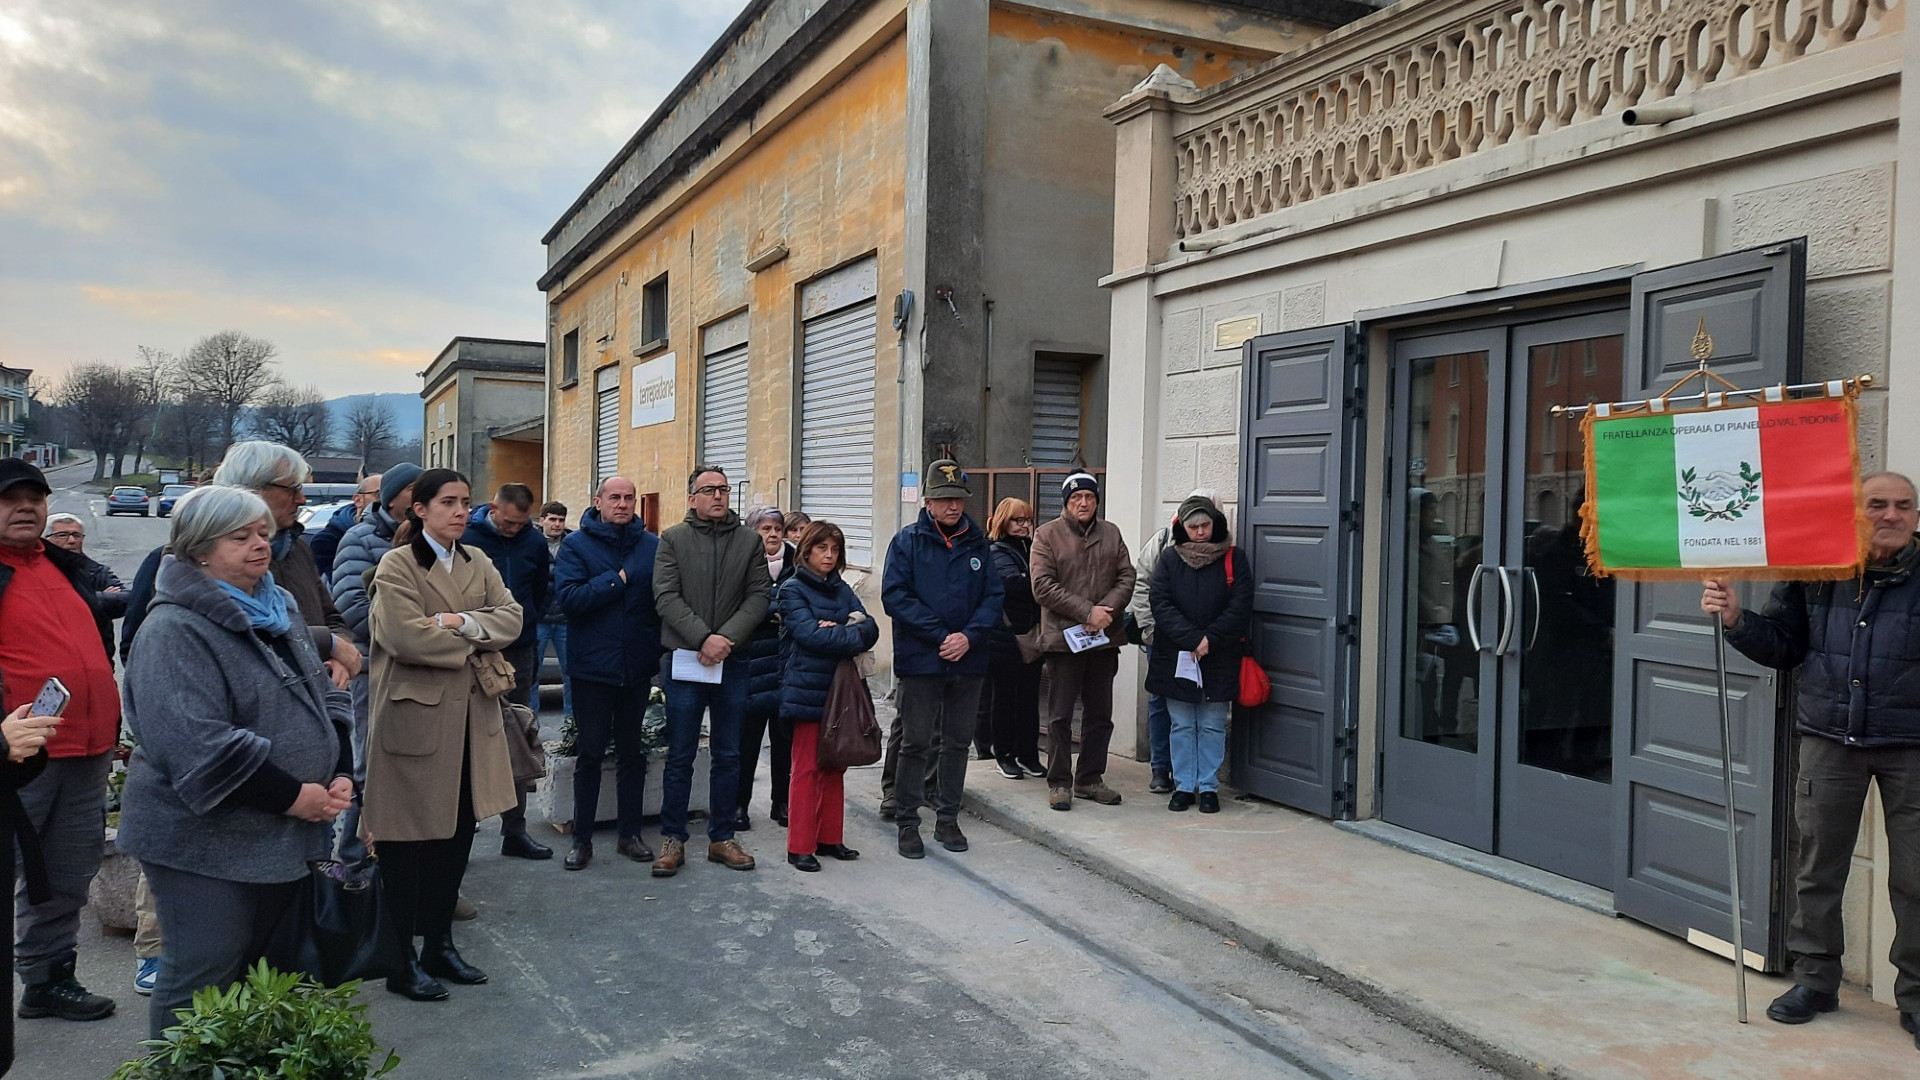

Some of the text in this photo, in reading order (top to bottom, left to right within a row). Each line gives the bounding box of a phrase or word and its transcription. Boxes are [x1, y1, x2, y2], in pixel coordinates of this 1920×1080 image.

[1602, 413, 1840, 440] FRATELLANZA OPERAIA DI PIANELLO VAL TIDONE
[1683, 536, 1762, 547] FONDATA NEL 1881
